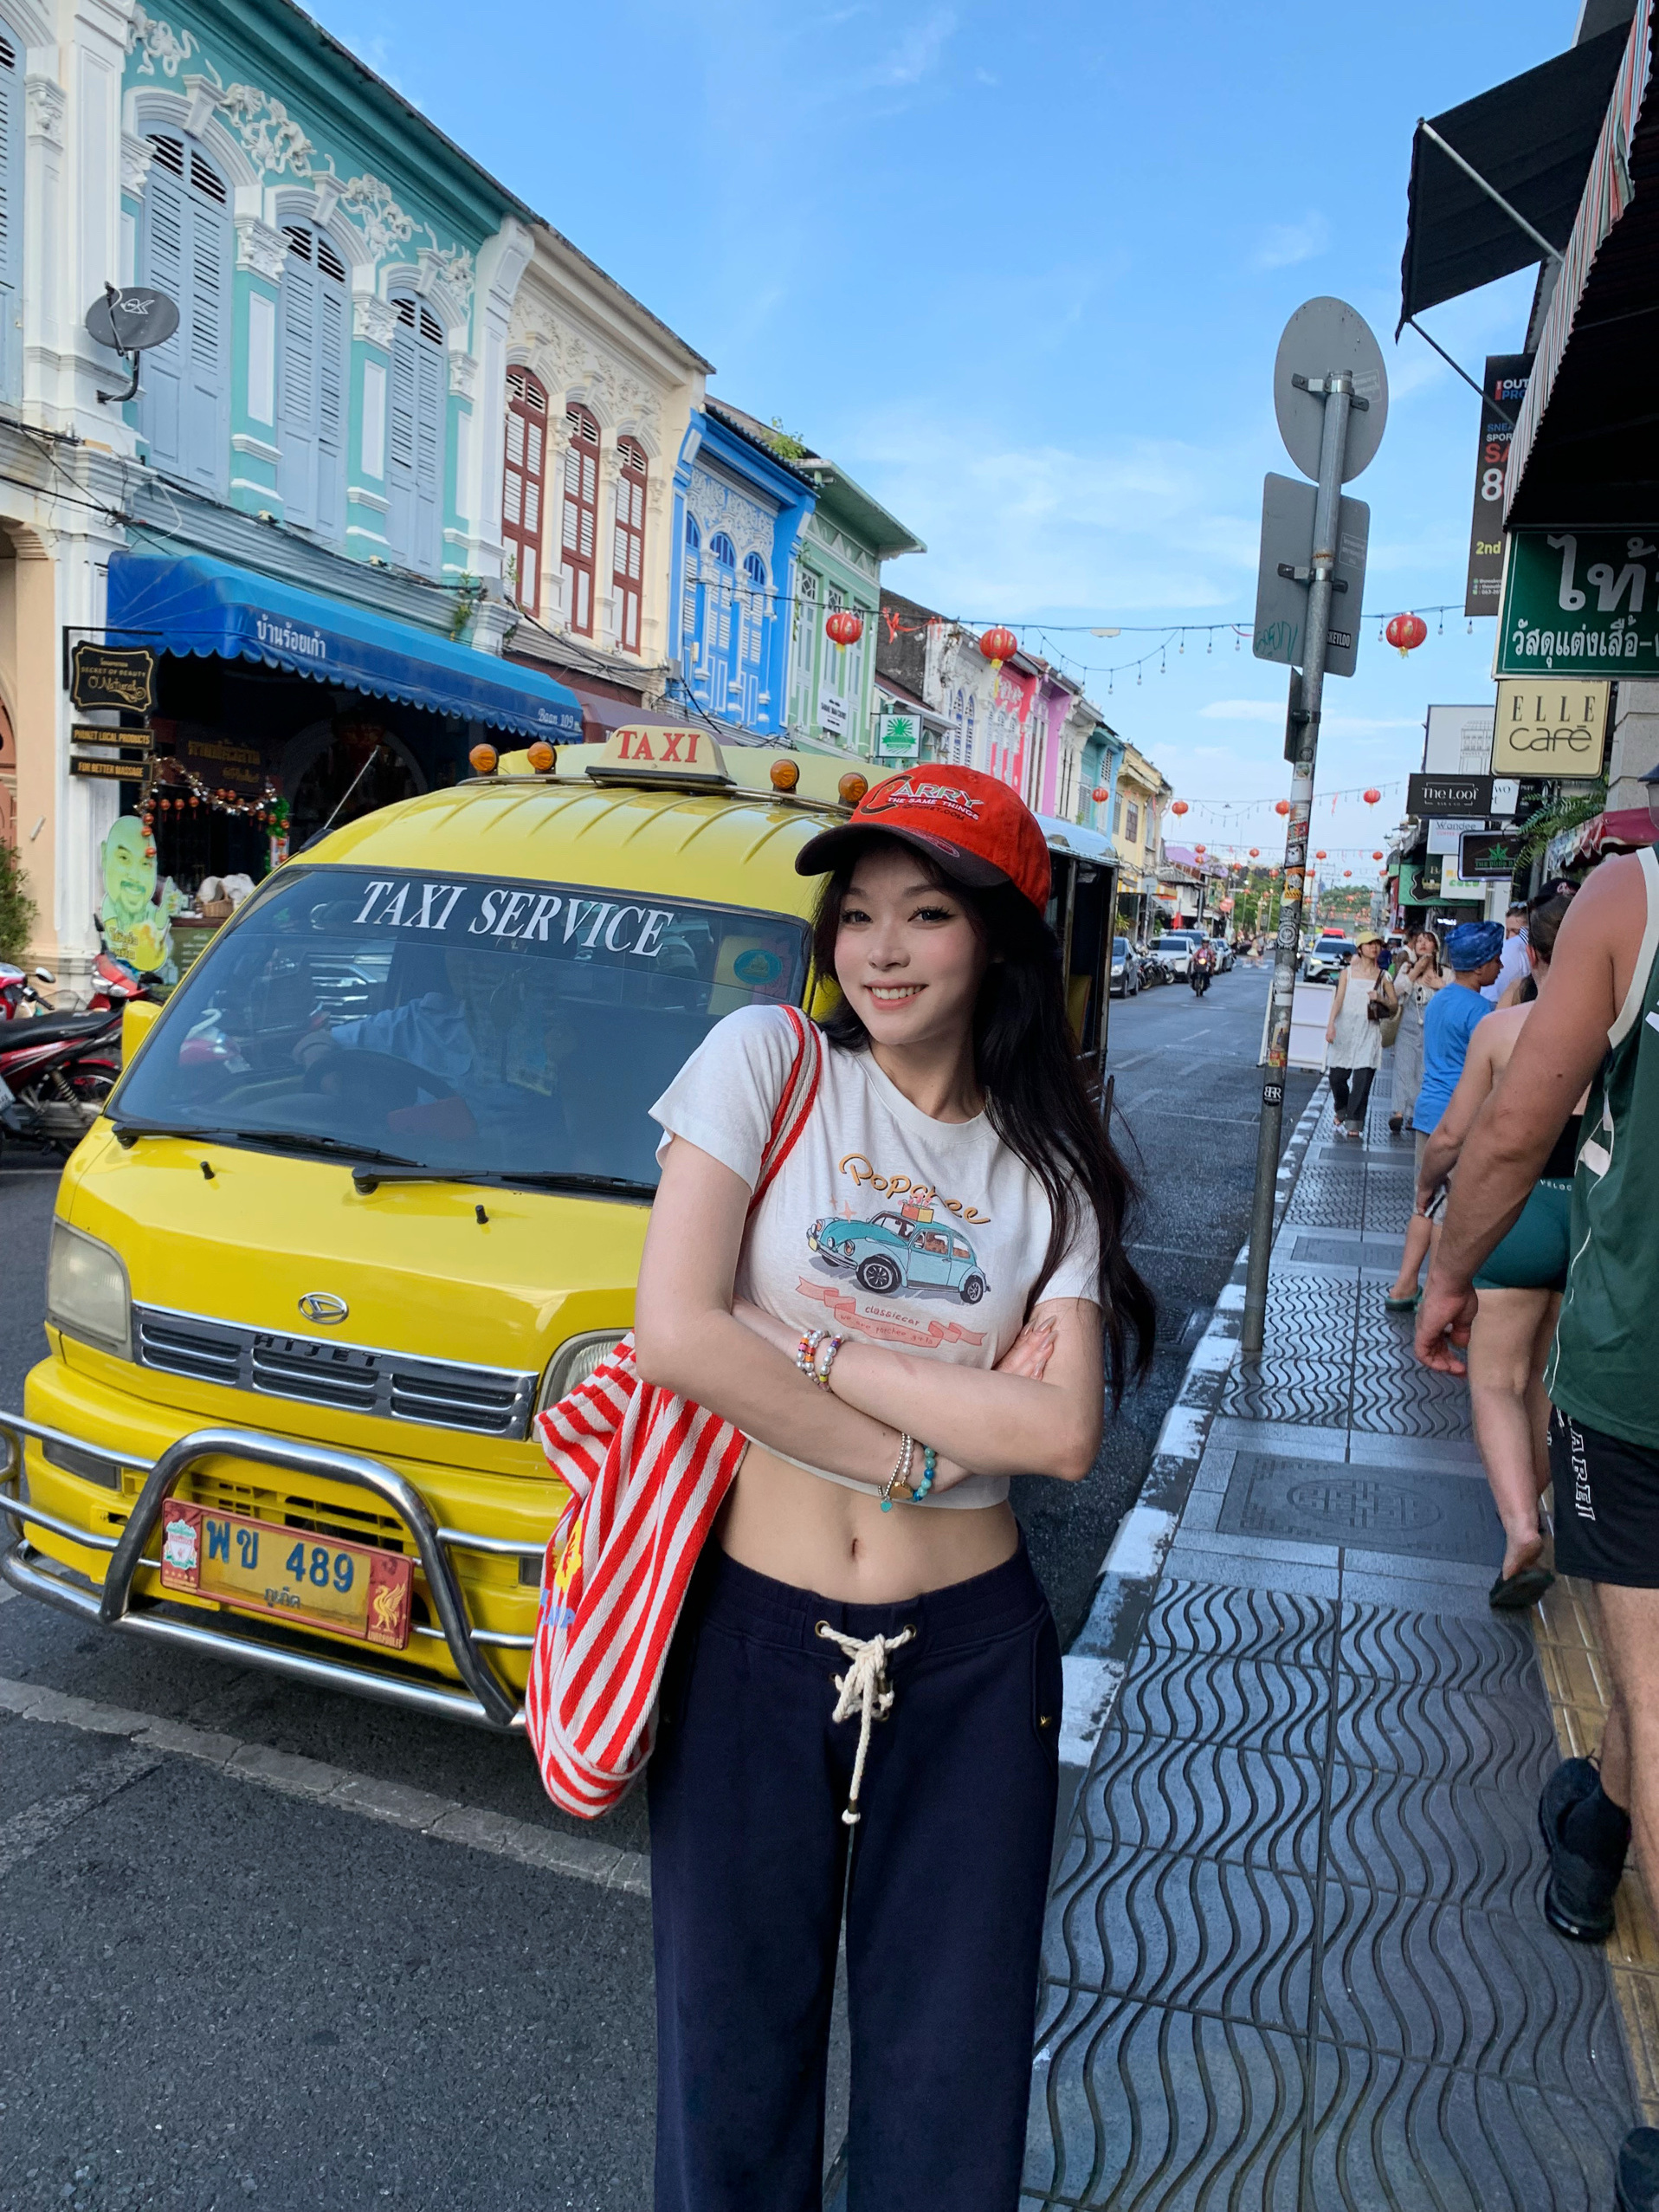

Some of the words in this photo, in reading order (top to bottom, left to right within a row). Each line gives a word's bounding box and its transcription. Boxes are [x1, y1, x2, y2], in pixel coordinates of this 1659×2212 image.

[1475, 541, 1501, 555] 2nd
[1546, 534, 1659, 613] ไท้
[256, 613, 326, 659] บ้านร้อยเก้า
[1513, 615, 1659, 669] วัสดุแต่งเสื้อ-
[538, 708, 558, 725] Baan
[560, 714, 574, 728] 109
[1511, 695, 1596, 722] ELLE
[616, 730, 700, 763] TAXI
[942, 800, 980, 820] THINGS
[1436, 820, 1476, 831] Wandee
[352, 880, 468, 930] TAXI
[468, 889, 674, 957] SERVICE
[254, 1333, 383, 1368] HIJET
[286, 1543, 354, 1594] 489
